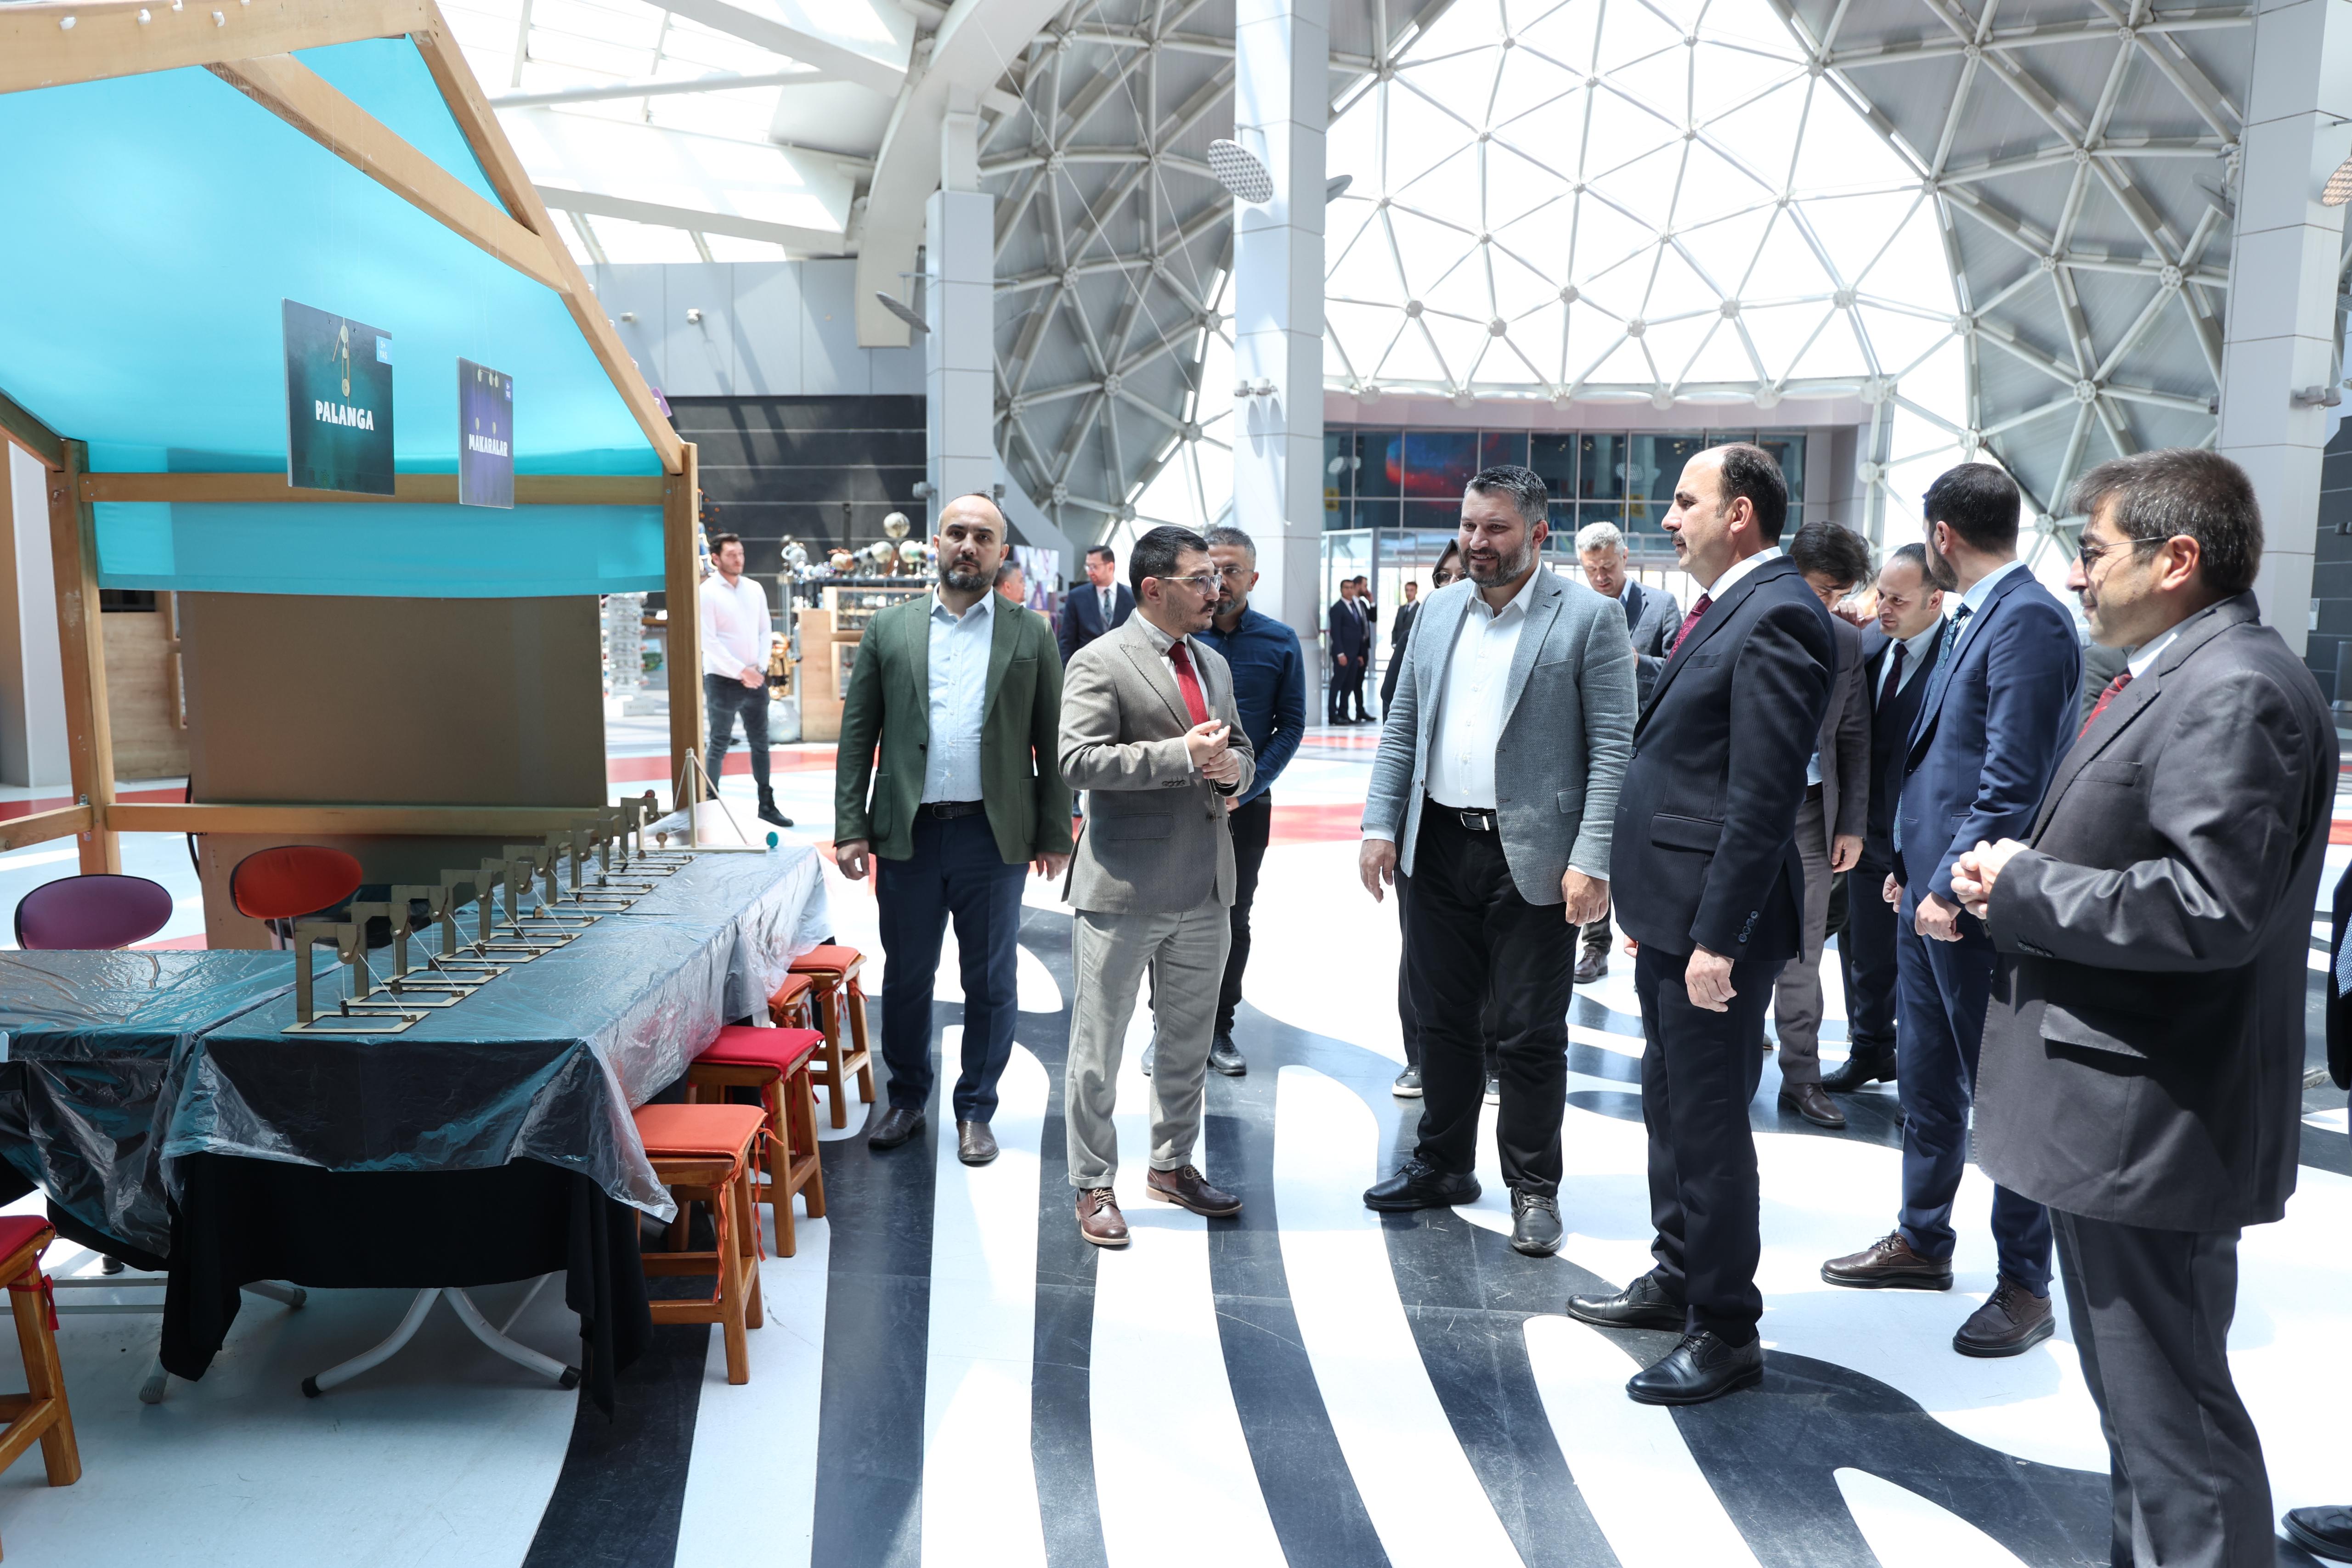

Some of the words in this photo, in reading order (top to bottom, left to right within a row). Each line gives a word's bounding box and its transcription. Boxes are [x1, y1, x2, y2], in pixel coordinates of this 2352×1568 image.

[379, 350, 388, 361] YAŞ
[316, 400, 374, 431] PALANGA
[469, 434, 508, 457] MAKARALAR
